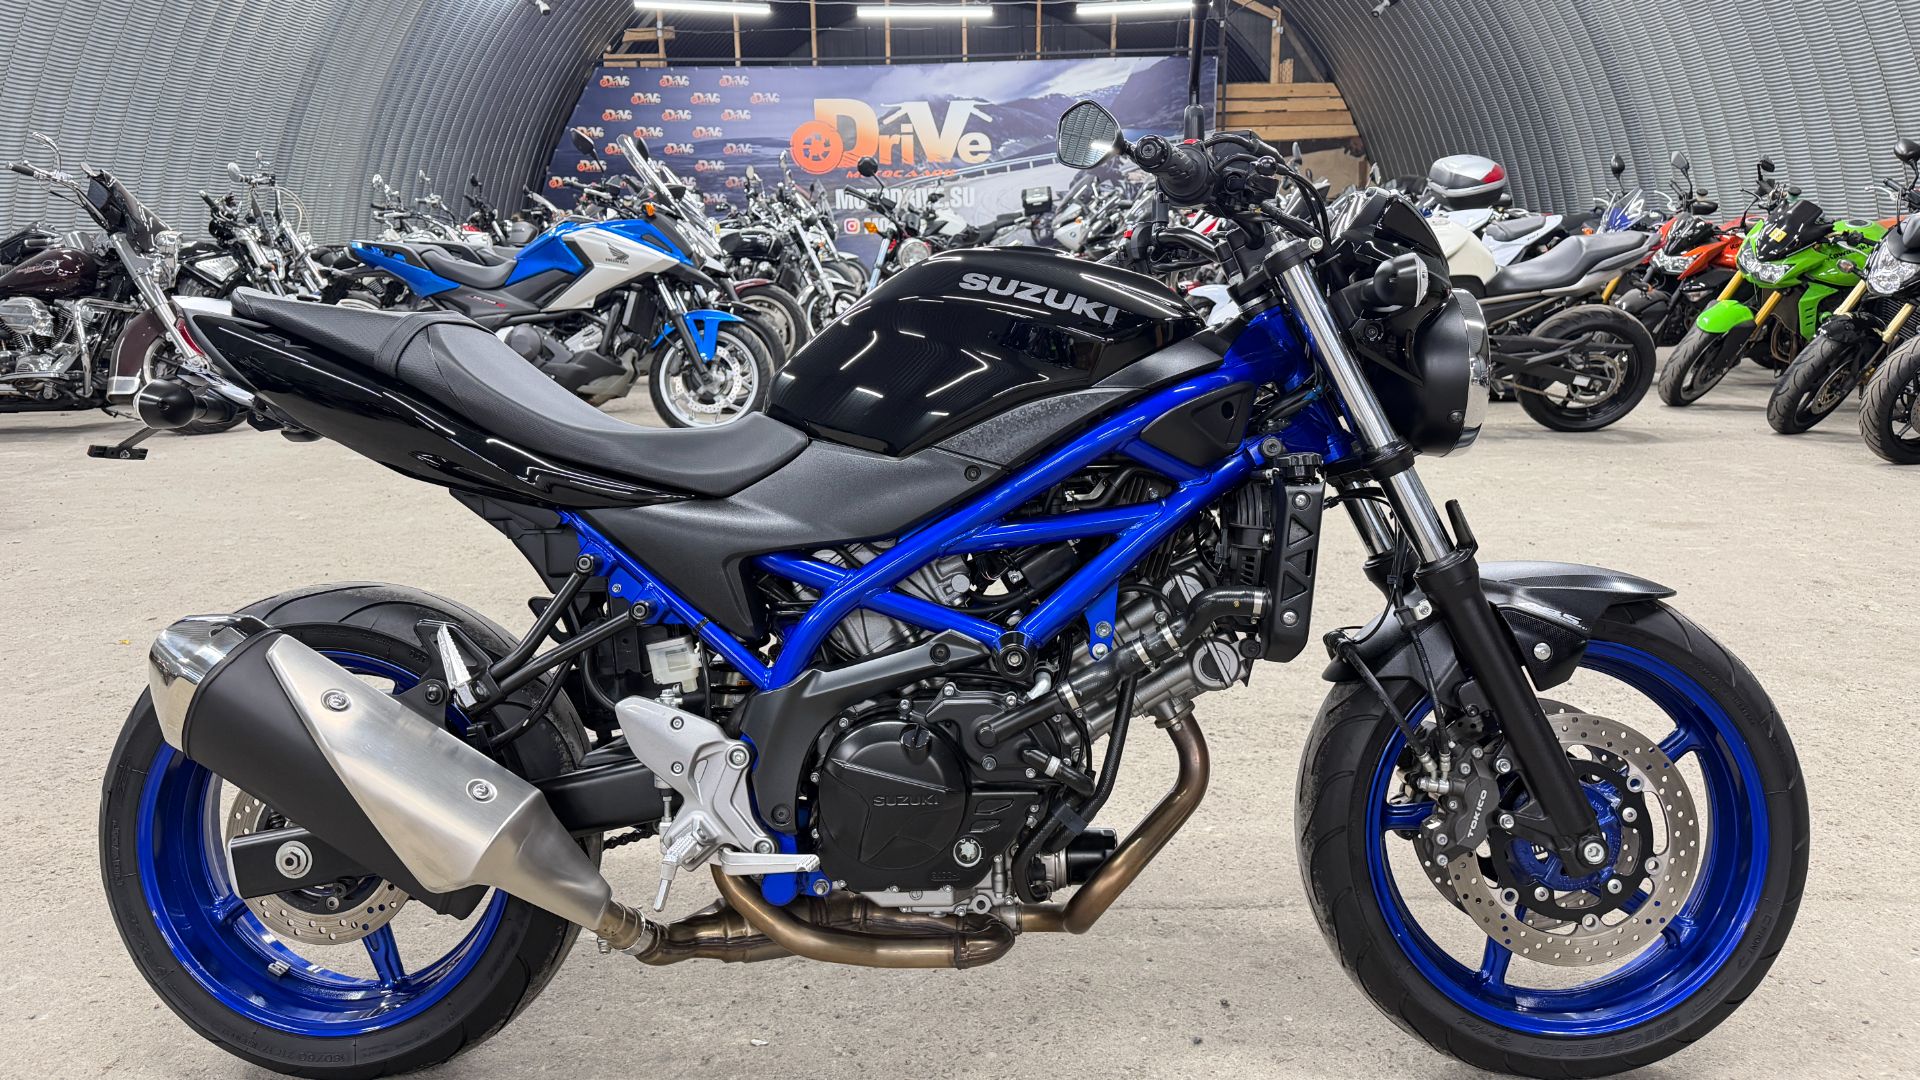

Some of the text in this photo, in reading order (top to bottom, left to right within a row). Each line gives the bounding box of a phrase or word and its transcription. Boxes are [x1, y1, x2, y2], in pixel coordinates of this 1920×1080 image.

[958, 272, 1120, 326] SUZUKI
[872, 795, 940, 807] SUZUKI
[1466, 789, 1488, 838] TOKICO
